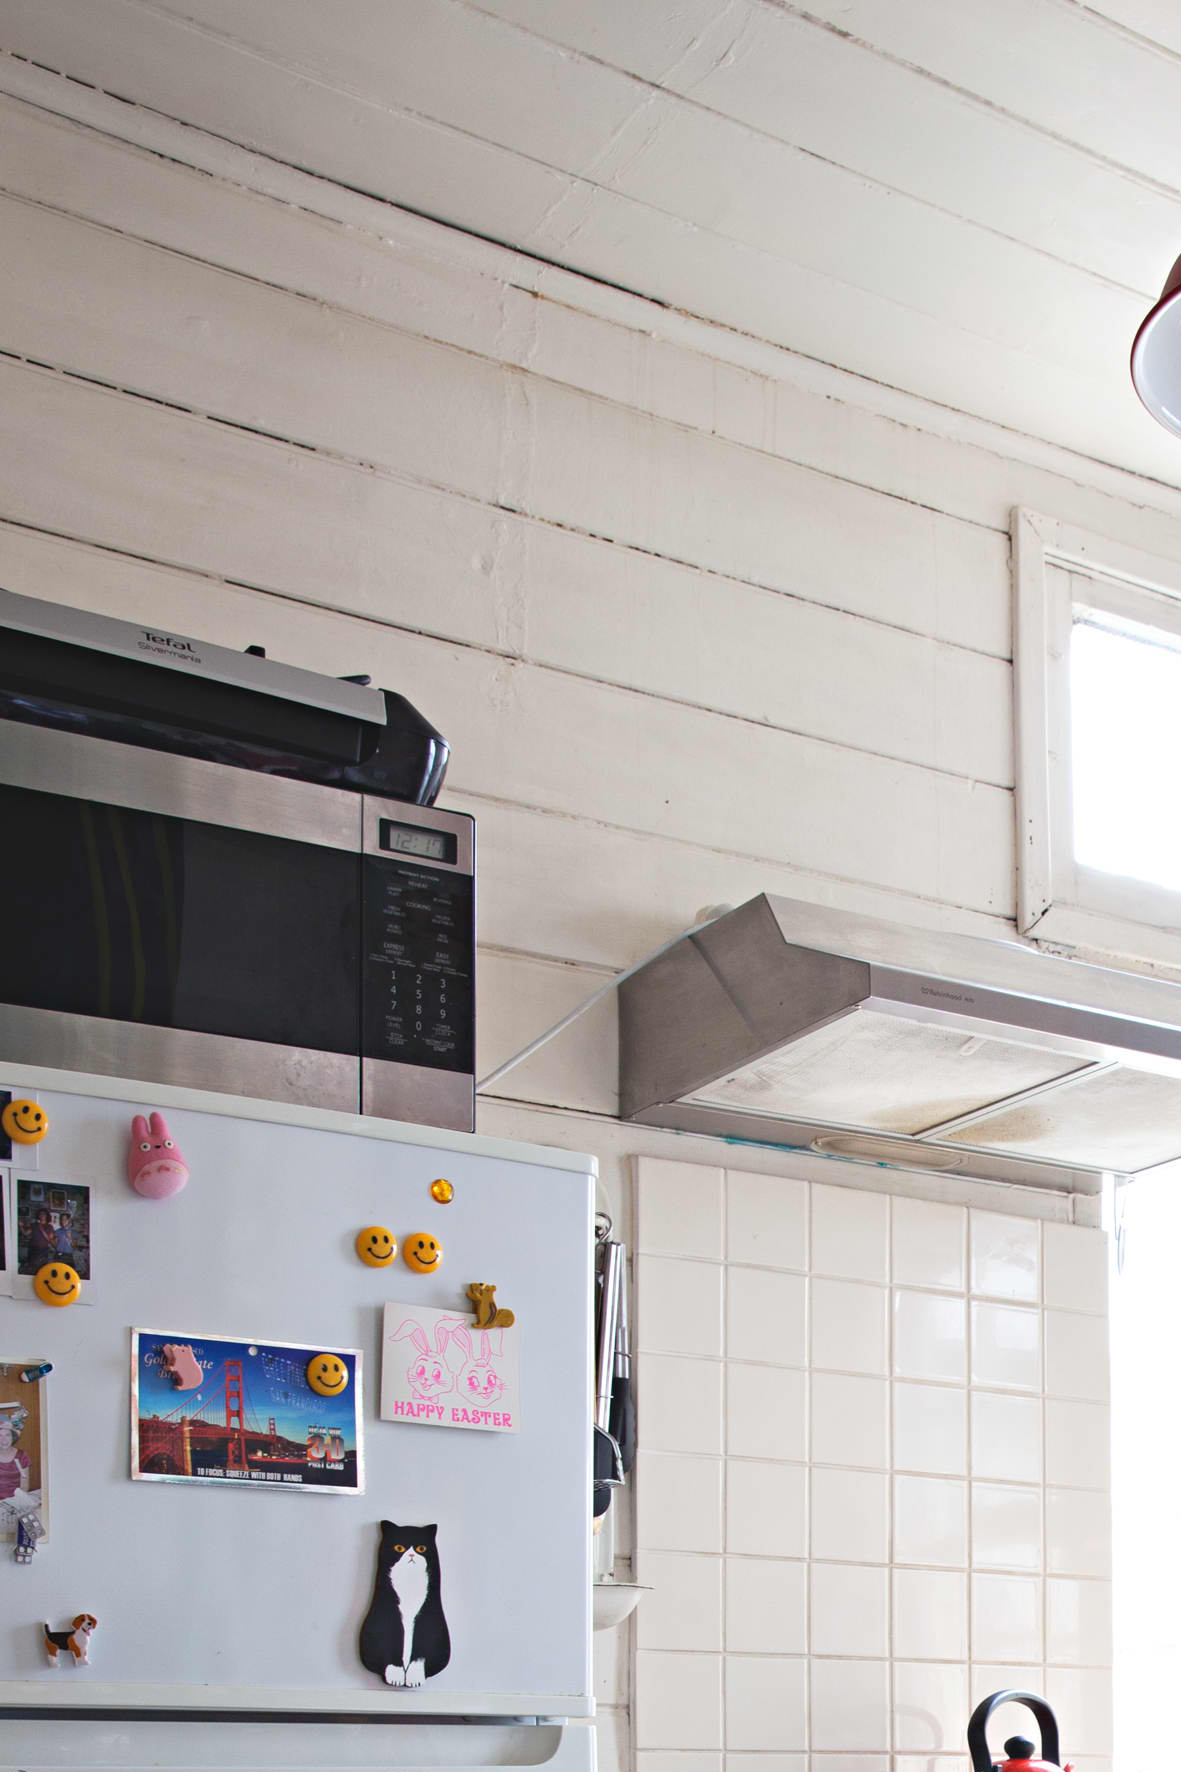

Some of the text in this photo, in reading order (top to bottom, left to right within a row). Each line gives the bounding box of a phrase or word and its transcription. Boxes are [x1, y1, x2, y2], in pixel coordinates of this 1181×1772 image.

[142, 630, 196, 653] Tefal
[384, 942, 404, 951] EXPRESS
[391, 970, 446, 988] 1 2 3
[390, 985, 446, 1003] 4 5 6
[391, 1001, 446, 1019] 7 8 9
[416, 1021, 422, 1031] 0
[394, 1400, 512, 1428] HAPPY EASTER
[306, 1434, 345, 1462] 3-D
[197, 1467, 303, 1482] TO FOCUS: SQUEEZE WITH BOTH HANDS
